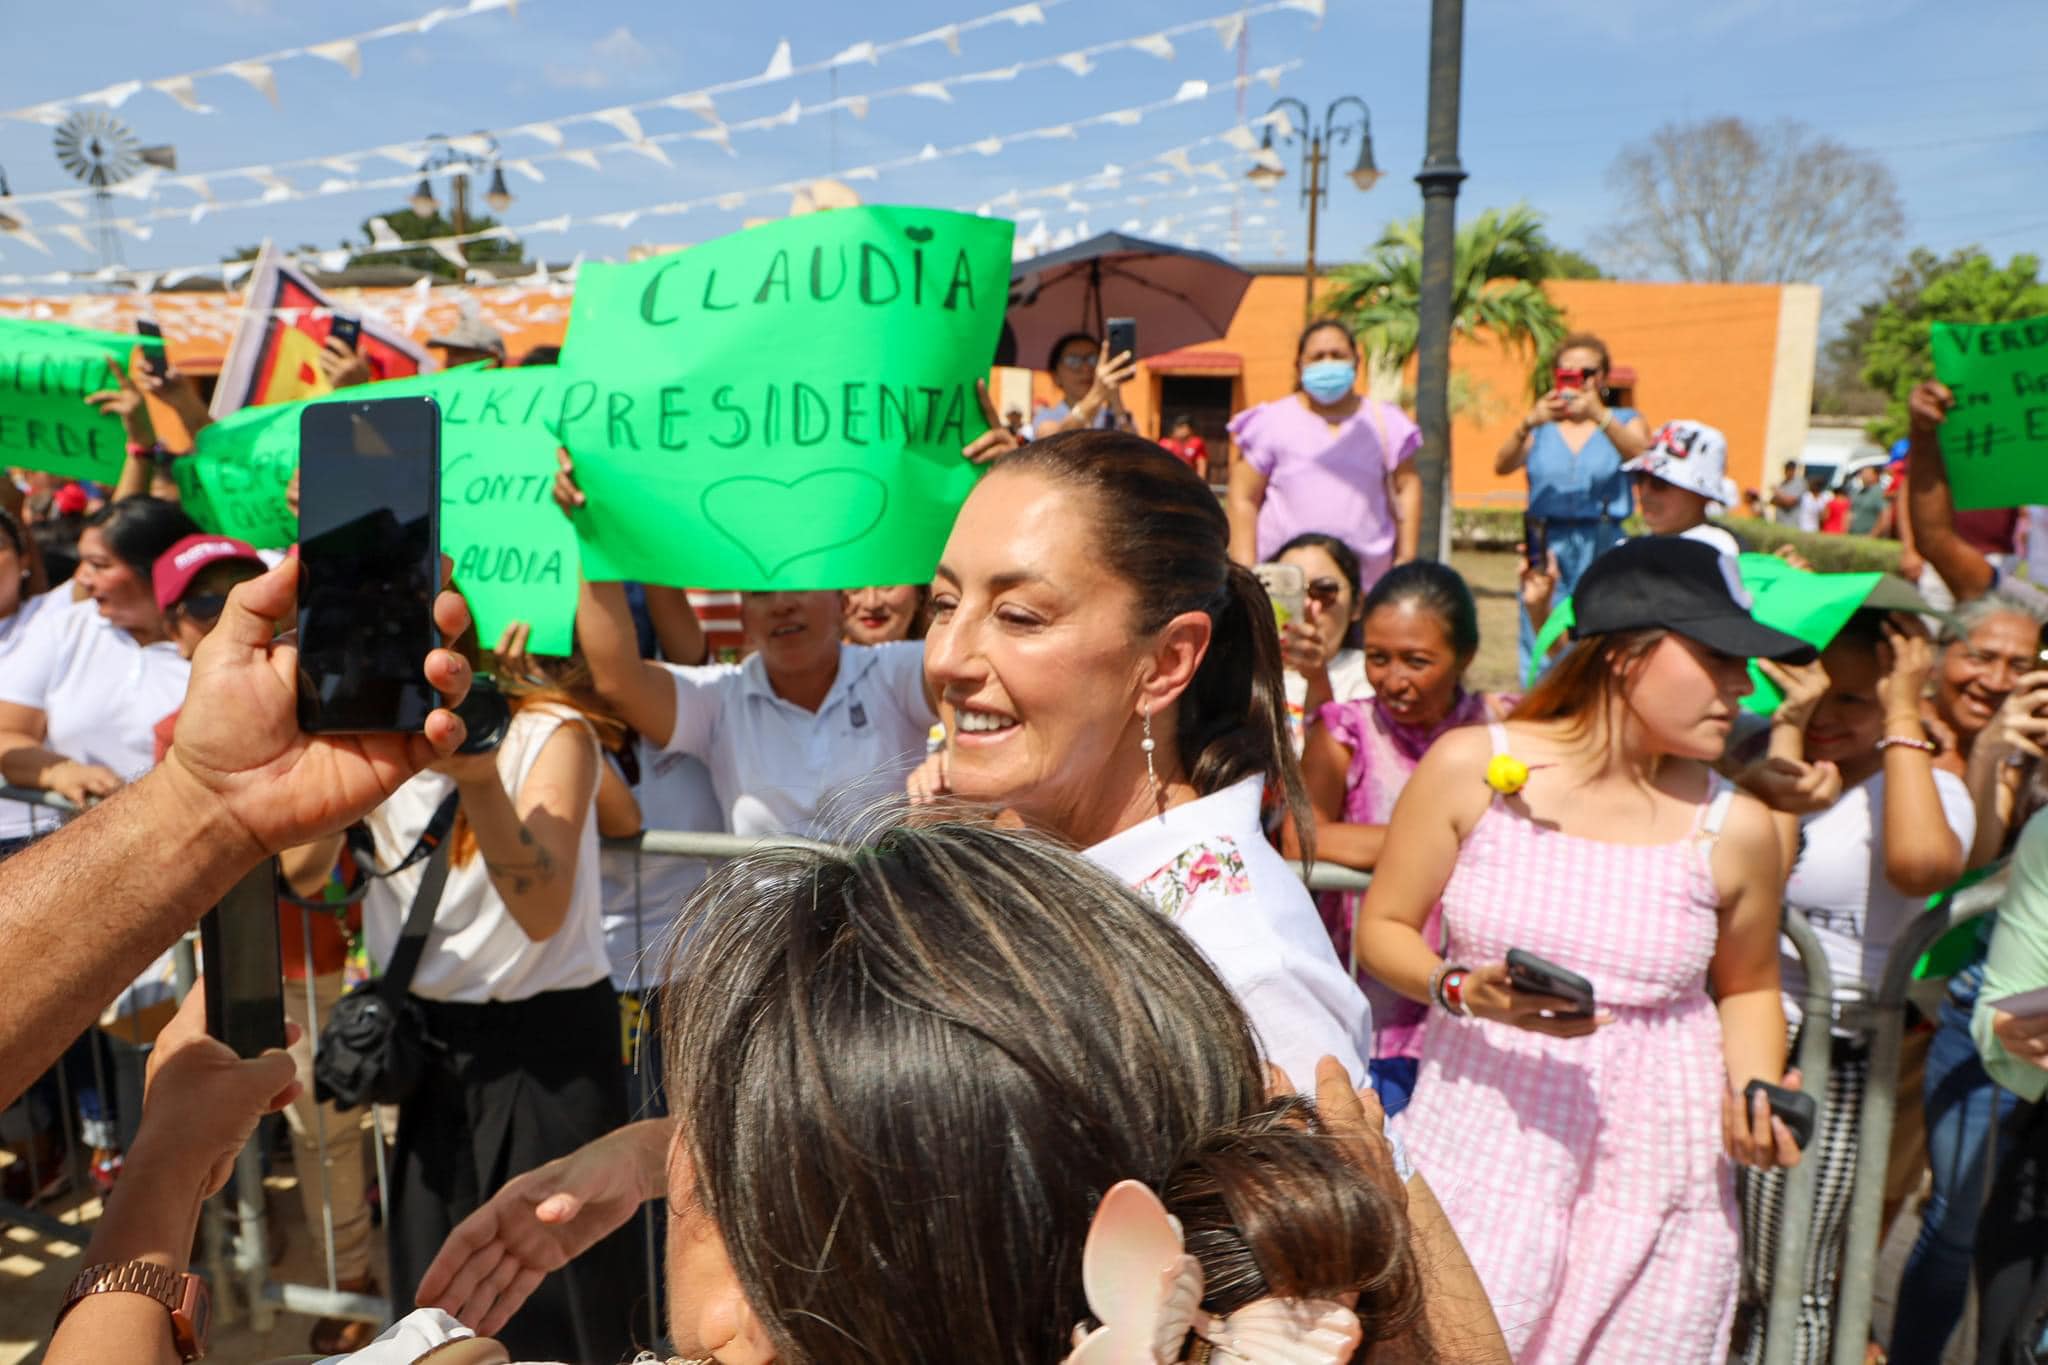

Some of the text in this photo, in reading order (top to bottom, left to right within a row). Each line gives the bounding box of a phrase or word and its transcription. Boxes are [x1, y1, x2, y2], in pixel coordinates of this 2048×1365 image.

[640, 227, 975, 326] CLAUDIA
[436, 386, 544, 424] LKI
[558, 381, 965, 452] PRESIDENTA
[445, 544, 562, 584] AUDIA
